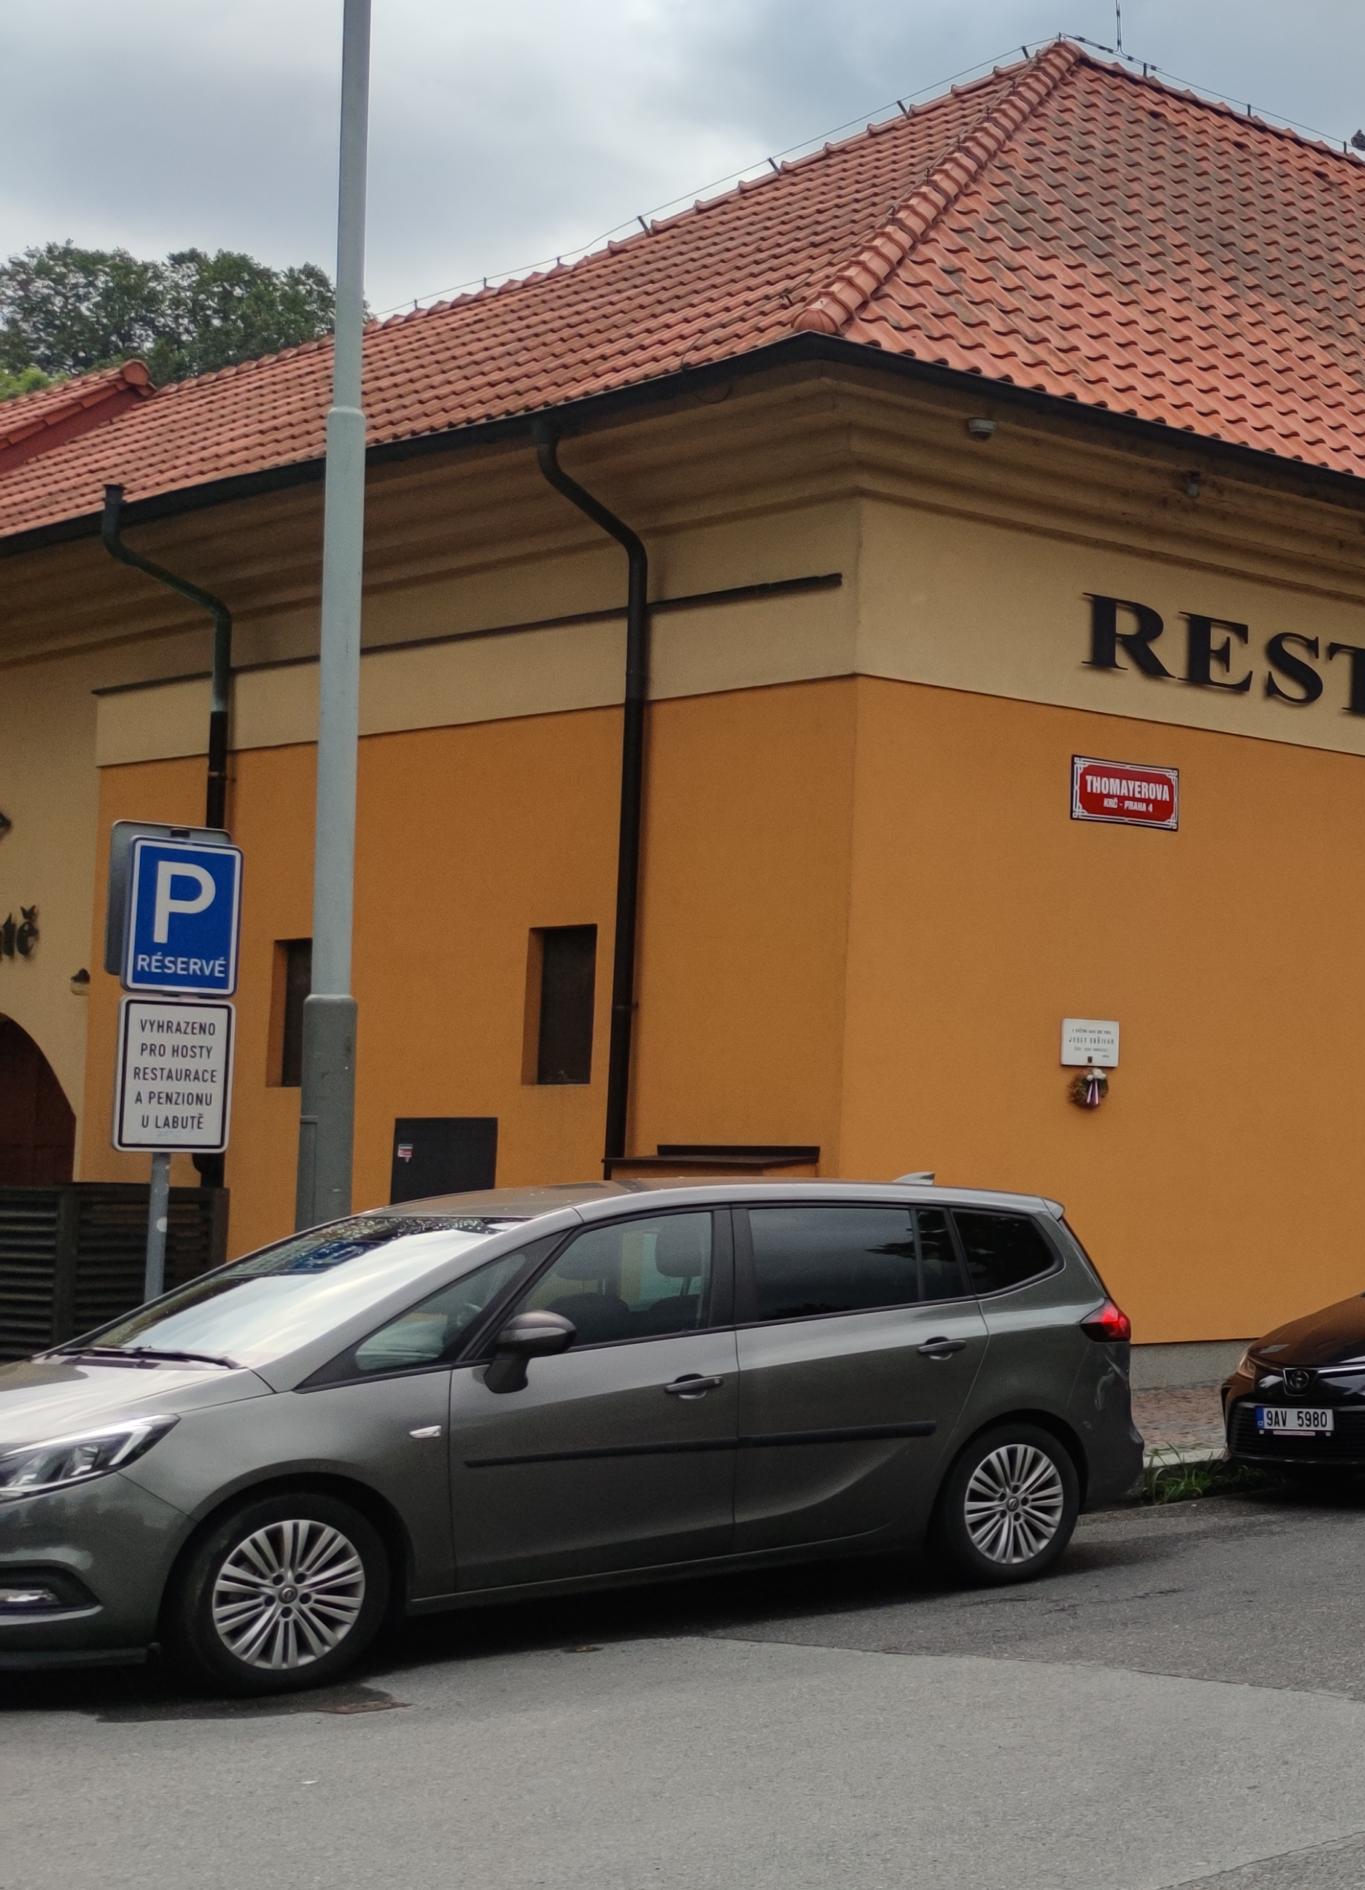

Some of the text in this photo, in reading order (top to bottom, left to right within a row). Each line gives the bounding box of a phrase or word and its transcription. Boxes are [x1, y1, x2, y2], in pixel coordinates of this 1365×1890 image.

[1085, 775, 1170, 802] THOMAYEROVA
[1103, 797, 1118, 808] KRČ
[1124, 801, 1147, 812] PRAHA
[1147, 803, 1153, 812] 4
[153, 861, 216, 944] P
[0, 905, 39, 958] tě
[137, 952, 226, 977] RÉSERVÉ
[140, 1019, 216, 1036] VYHRAZENO
[140, 1043, 213, 1059] PRO HOSTY
[134, 1066, 217, 1083] RESTAURACE
[134, 1091, 212, 1106] A PENZIONU
[141, 1113, 204, 1130] U LABUTĚ
[1266, 1410, 1287, 1427] 9AV
[1297, 1411, 1328, 1428] 5980
